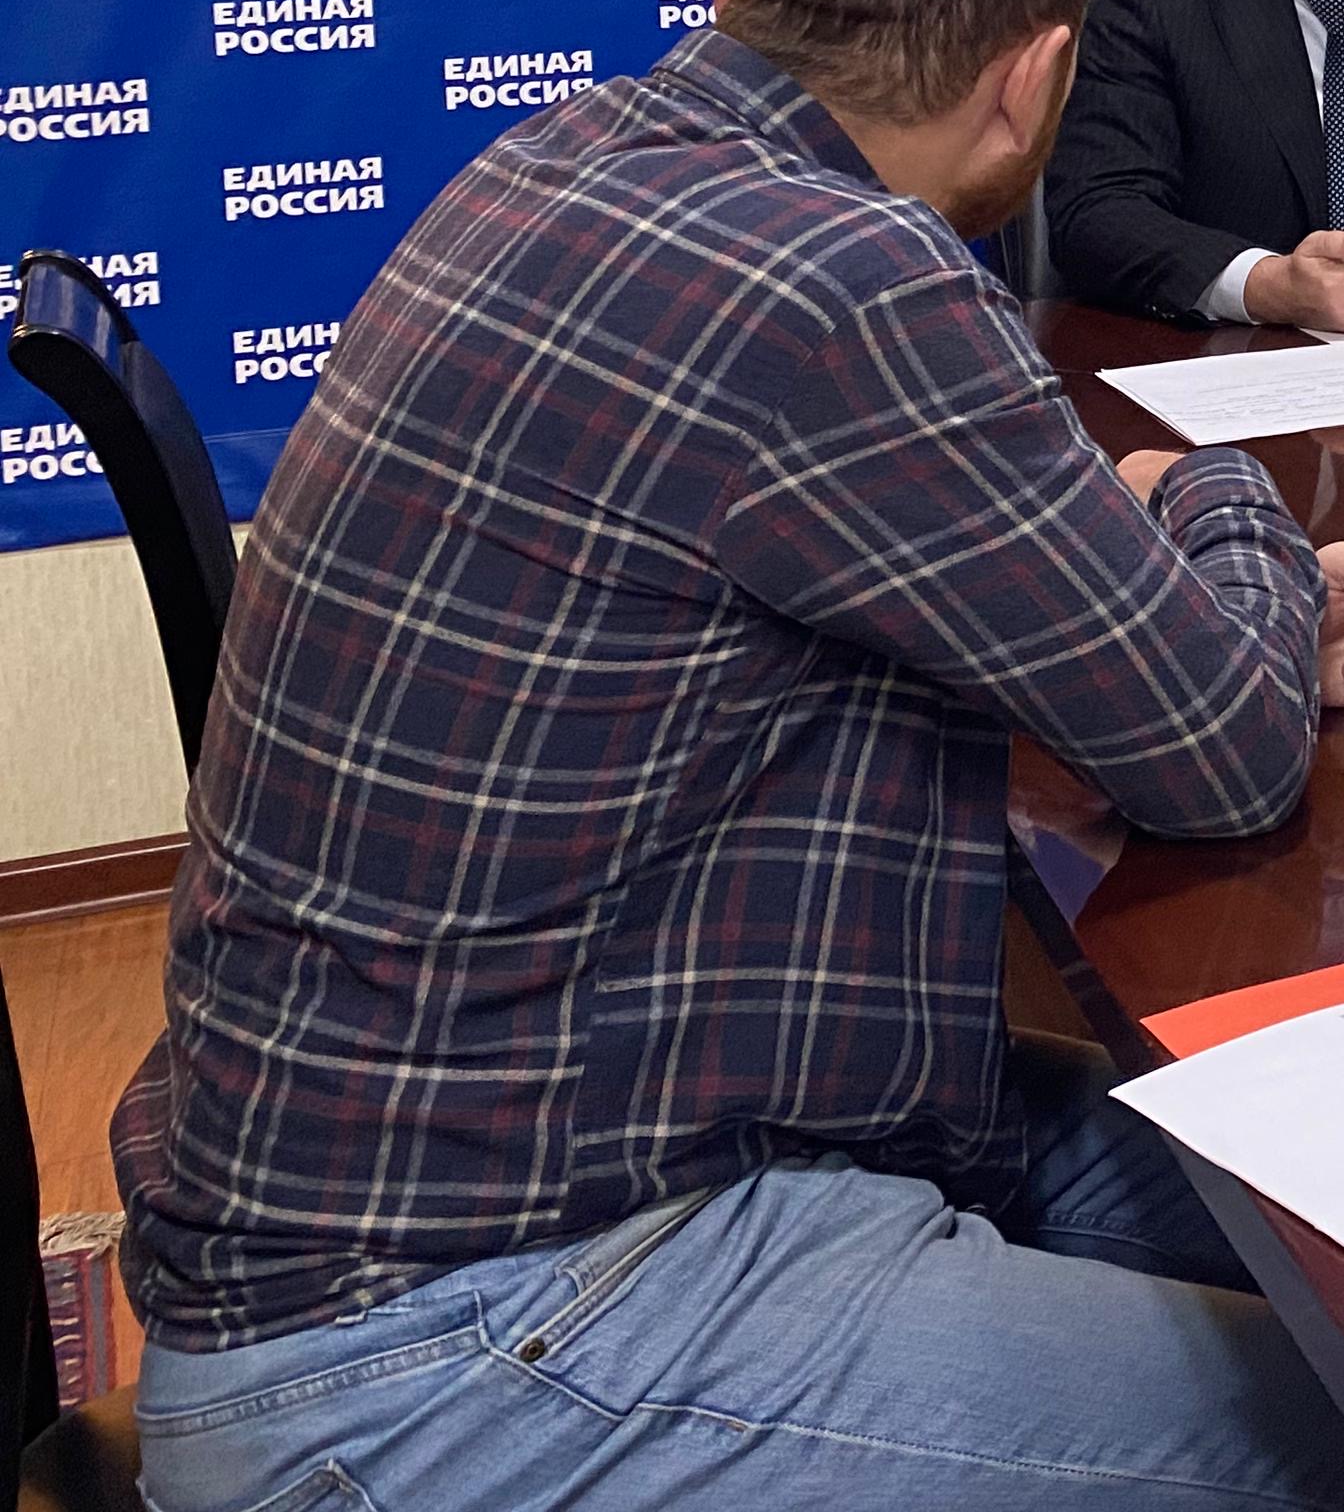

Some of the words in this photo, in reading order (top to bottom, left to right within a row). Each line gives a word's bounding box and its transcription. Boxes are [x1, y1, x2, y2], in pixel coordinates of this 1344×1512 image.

[215, 24, 375, 56] РОССИЯ
[224, 157, 382, 191] ЕДИНАЯ
[225, 185, 384, 220] РОССИЯ
